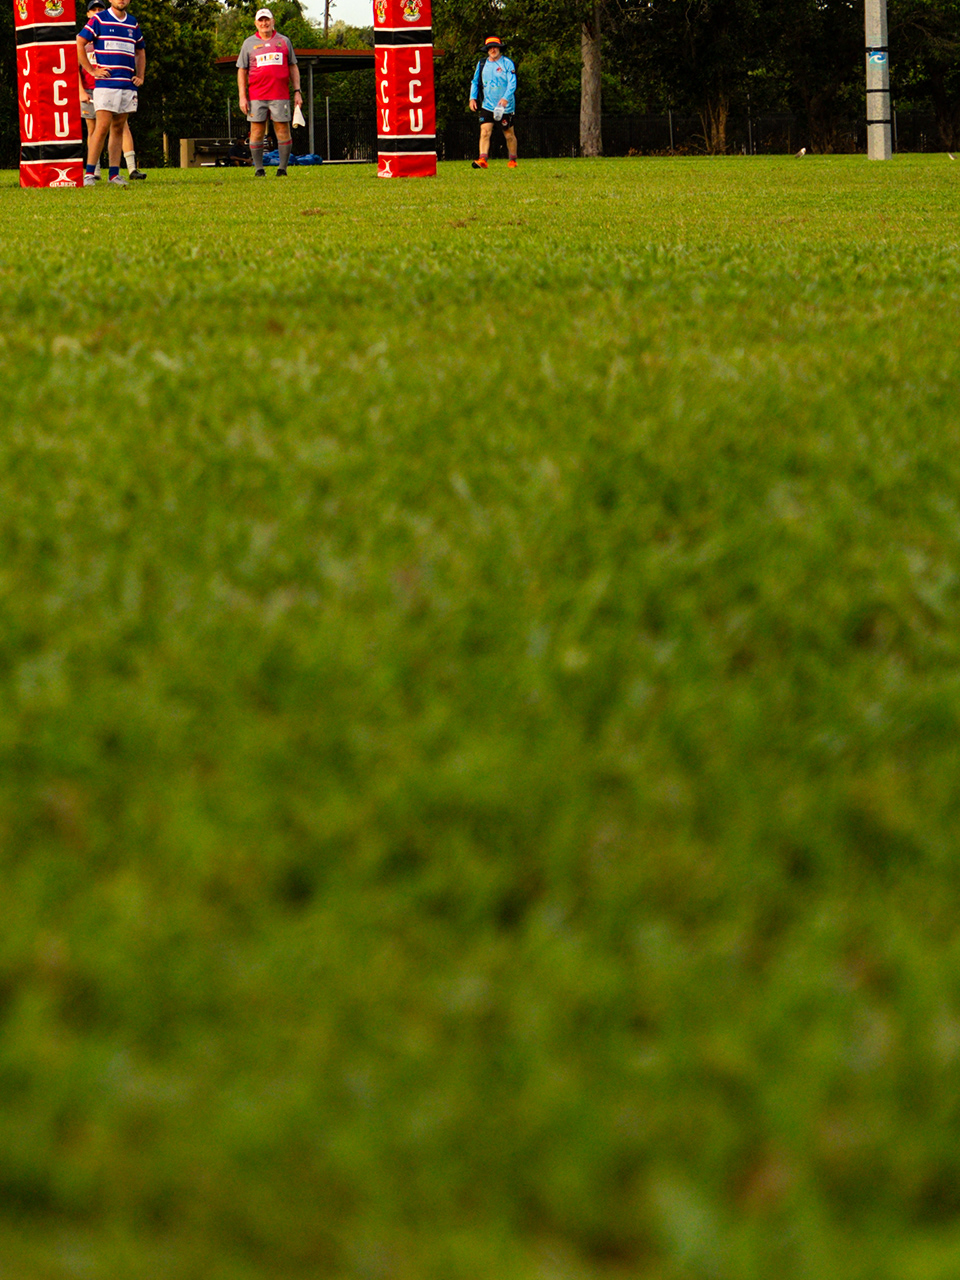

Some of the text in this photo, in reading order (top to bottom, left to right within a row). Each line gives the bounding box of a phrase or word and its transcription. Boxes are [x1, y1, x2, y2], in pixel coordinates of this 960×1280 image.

[22, 50, 34, 139] JCU
[52, 47, 70, 138] JCU
[408, 49, 424, 132] JCU
